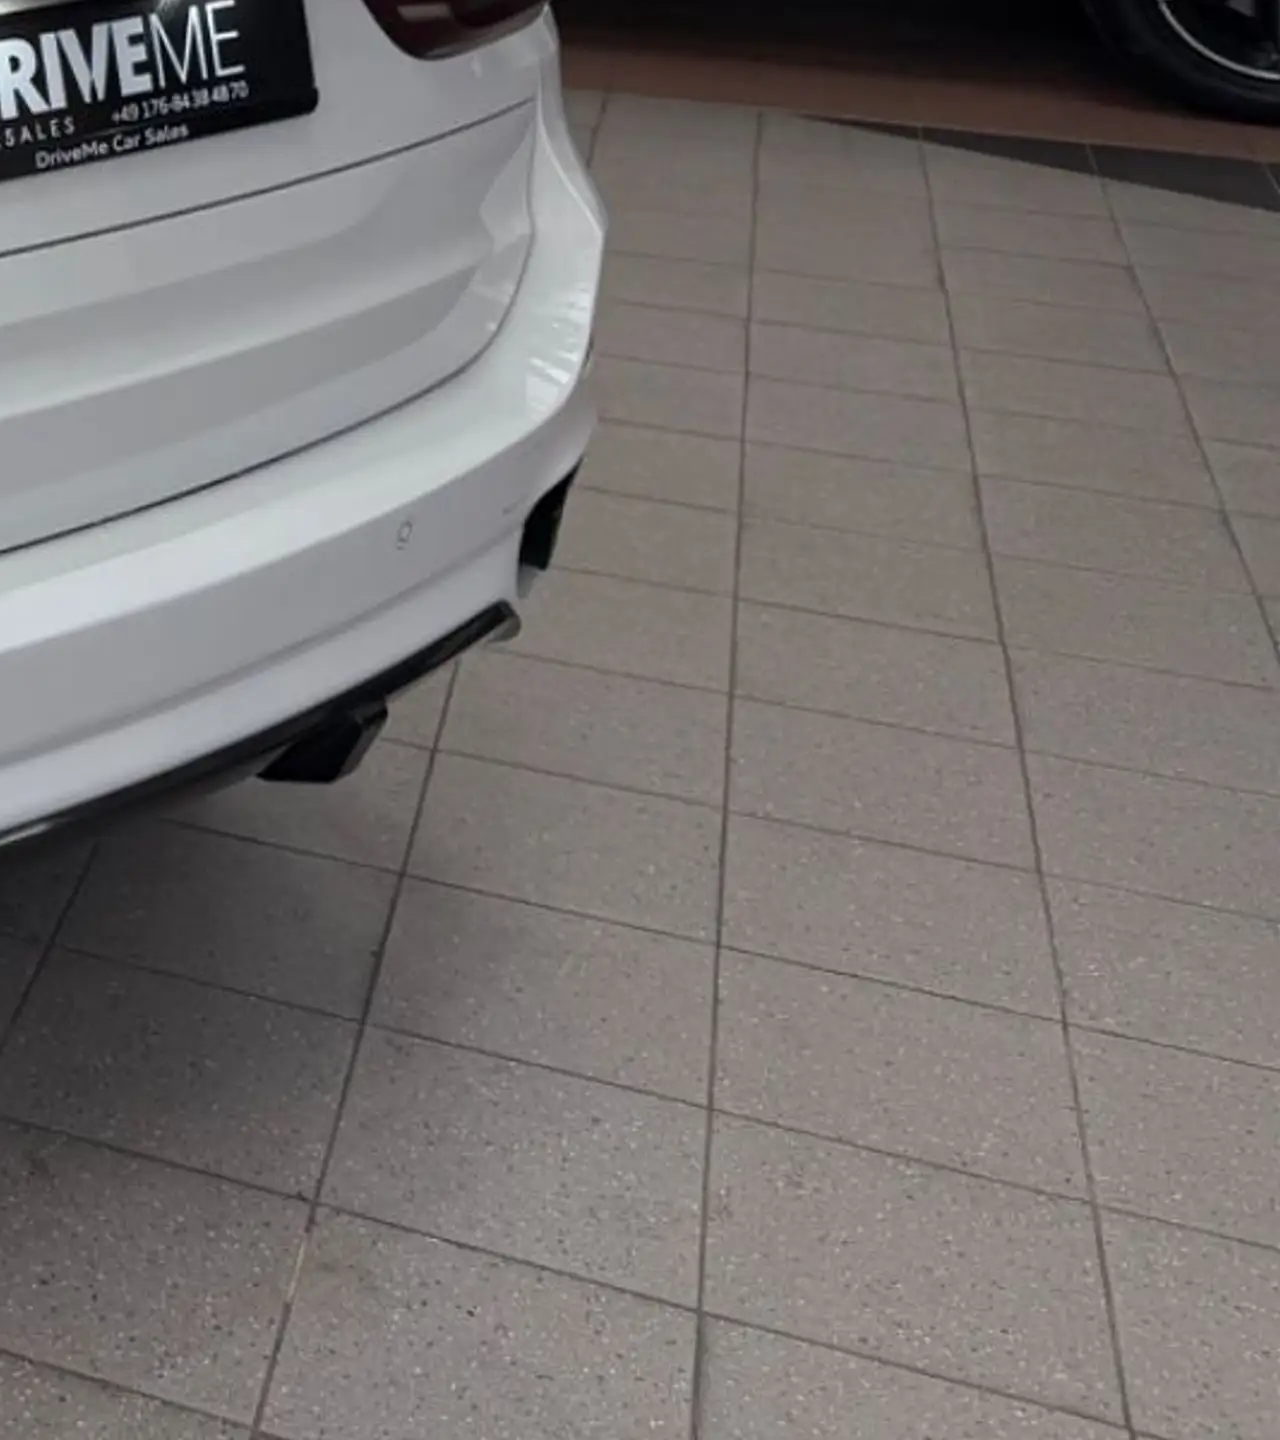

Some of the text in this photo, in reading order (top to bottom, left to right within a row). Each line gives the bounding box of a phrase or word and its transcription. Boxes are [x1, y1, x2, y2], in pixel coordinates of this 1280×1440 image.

[35, 123, 189, 169] DriveMe Car Sales
